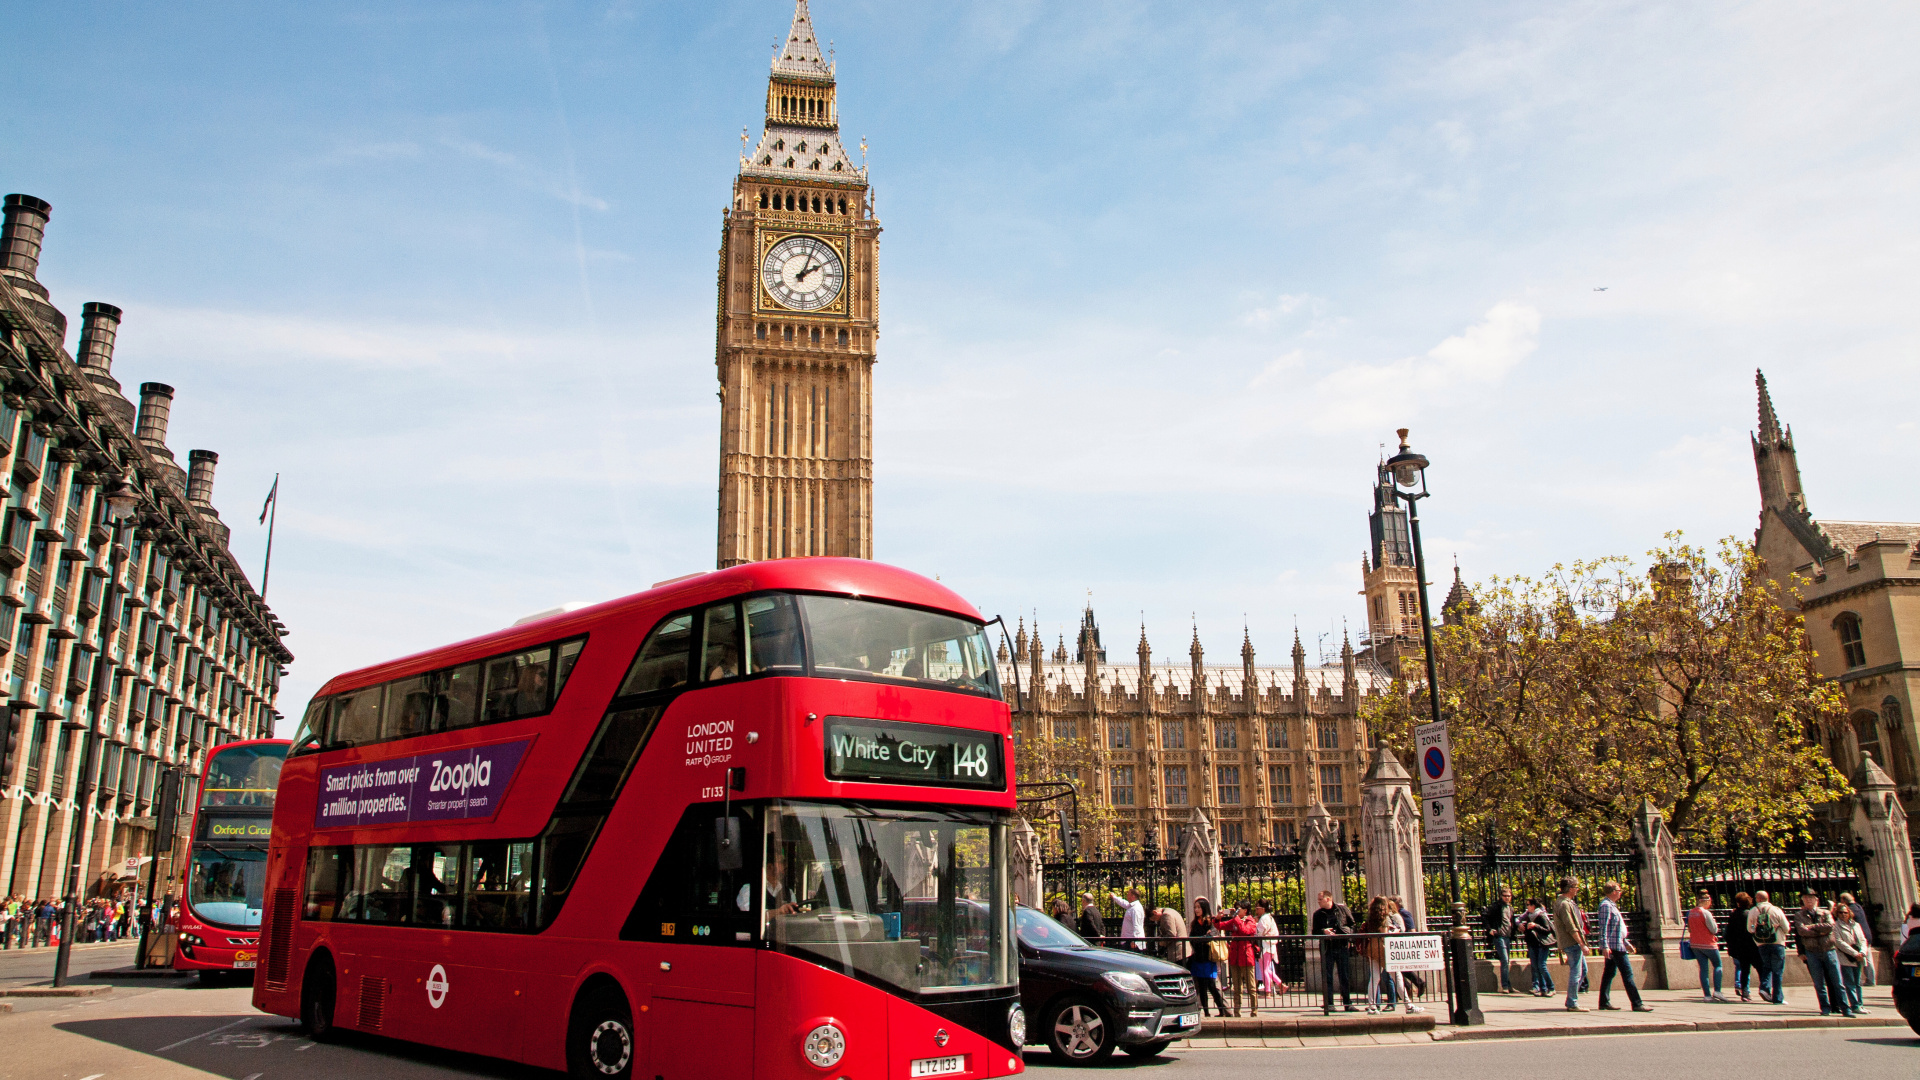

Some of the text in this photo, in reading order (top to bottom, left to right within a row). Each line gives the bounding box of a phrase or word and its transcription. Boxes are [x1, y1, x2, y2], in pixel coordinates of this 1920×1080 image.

[687, 720, 734, 738] LONDON
[1416, 724, 1444, 736] Controlled
[686, 737, 733, 755] UNITED
[1422, 734, 1442, 746] ZONE
[685, 754, 732, 767] RATP GROUP
[833, 734, 989, 778] White City 148
[326, 766, 420, 793] Smart picks from over
[429, 754, 492, 796] Zoopla
[702, 786, 724, 799] LT133
[323, 793, 407, 818] a million properties.
[427, 799, 447, 811] Smarter
[469, 795, 488, 807] search
[213, 824, 272, 835] Oxford Circu
[1390, 940, 1437, 950] PARLIAMENT
[1390, 950, 1440, 960] SQUARE SW1
[919, 1058, 956, 1074] LTZ 1133
